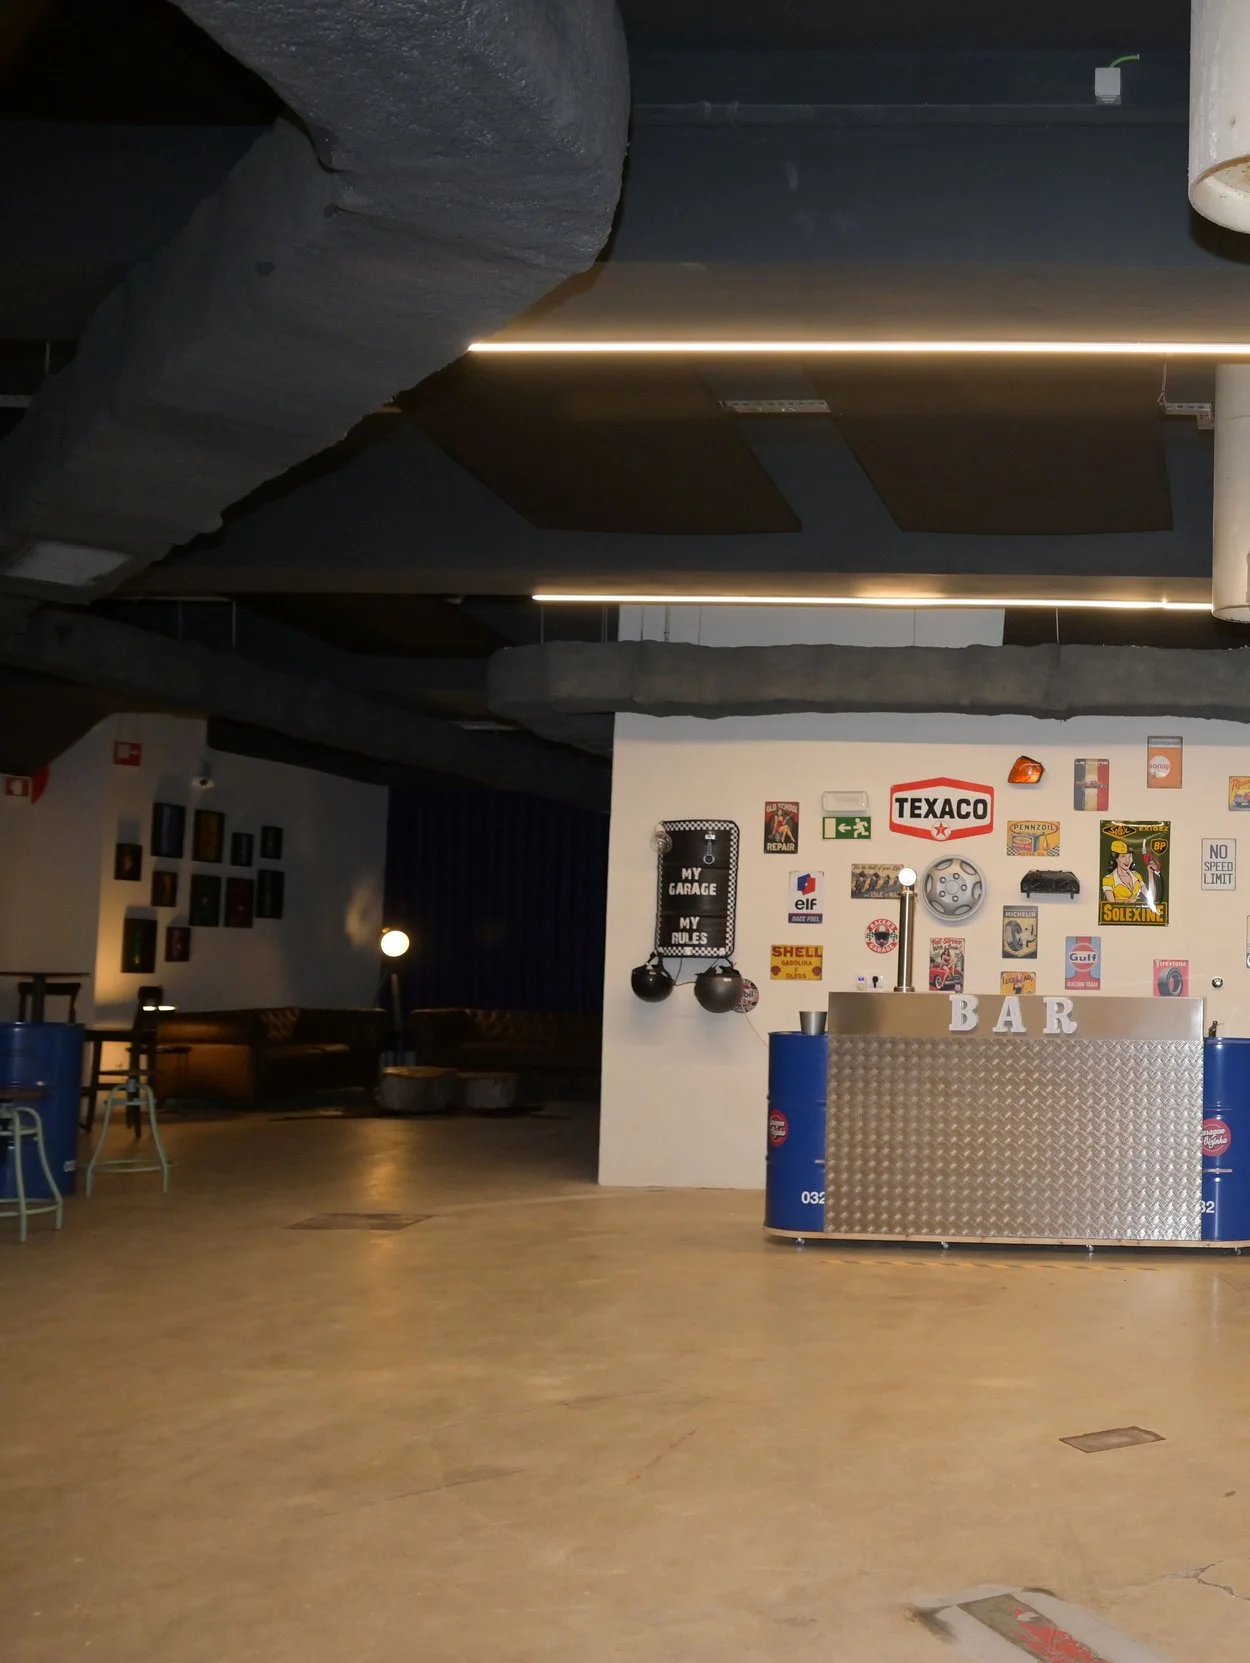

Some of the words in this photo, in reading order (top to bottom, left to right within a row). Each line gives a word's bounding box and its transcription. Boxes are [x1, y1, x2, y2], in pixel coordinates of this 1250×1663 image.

[895, 797, 988, 820] TEXACO
[767, 842, 795, 852] REPAIR
[1154, 841, 1166, 851] BP
[1209, 844, 1228, 859] NO
[1204, 861, 1233, 872] SPEED
[682, 867, 701, 880] MY
[1204, 873, 1233, 884] LIMIT
[668, 882, 717, 896] GARAGE
[795, 898, 817, 910] elf
[1103, 903, 1164, 922] SOLEXINE
[679, 916, 700, 929] MY
[671, 931, 708, 945] RULES
[772, 946, 823, 957] SHELL
[1069, 952, 1097, 962] Gulf
[743, 990, 754, 998] bil
[949, 995, 1078, 1034] BAR
